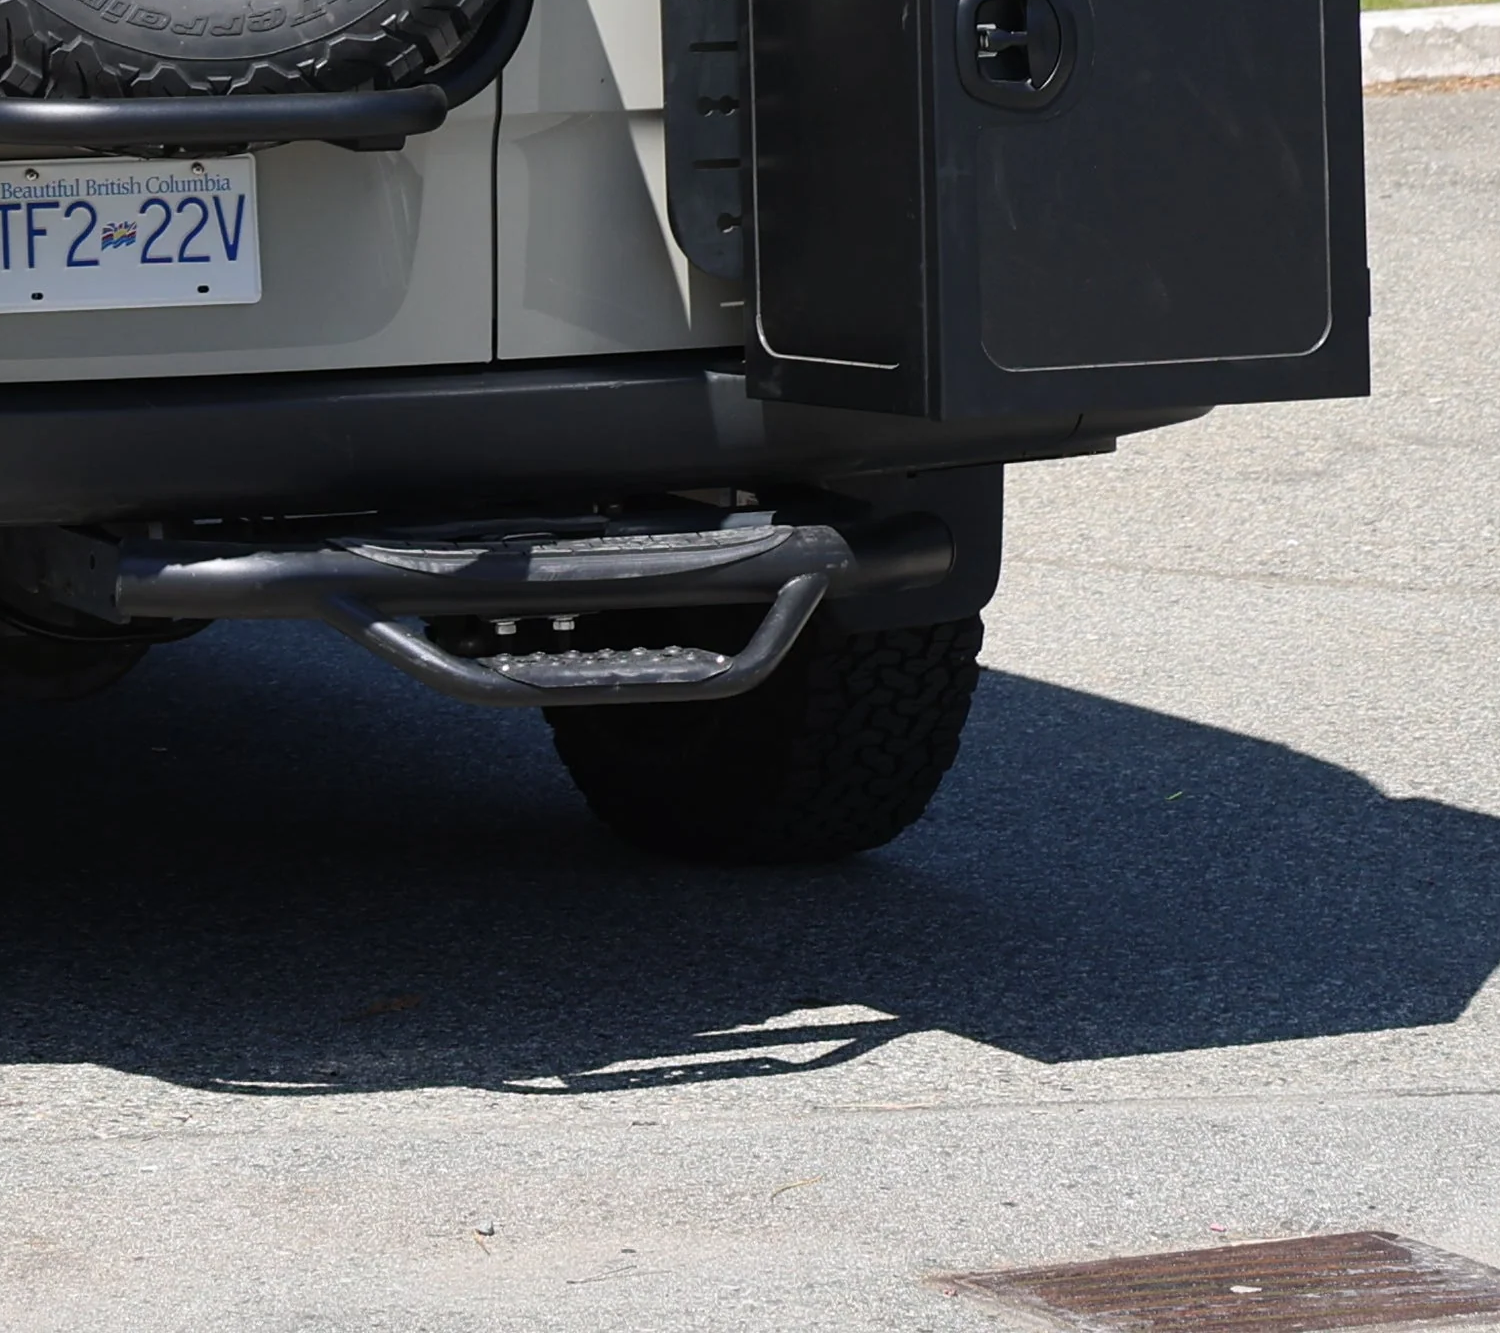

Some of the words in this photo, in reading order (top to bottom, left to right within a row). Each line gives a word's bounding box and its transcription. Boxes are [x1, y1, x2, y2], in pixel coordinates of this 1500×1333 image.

[0, 181, 80, 200] Beautiful
[85, 178, 141, 196] British
[145, 174, 231, 194] Columbia
